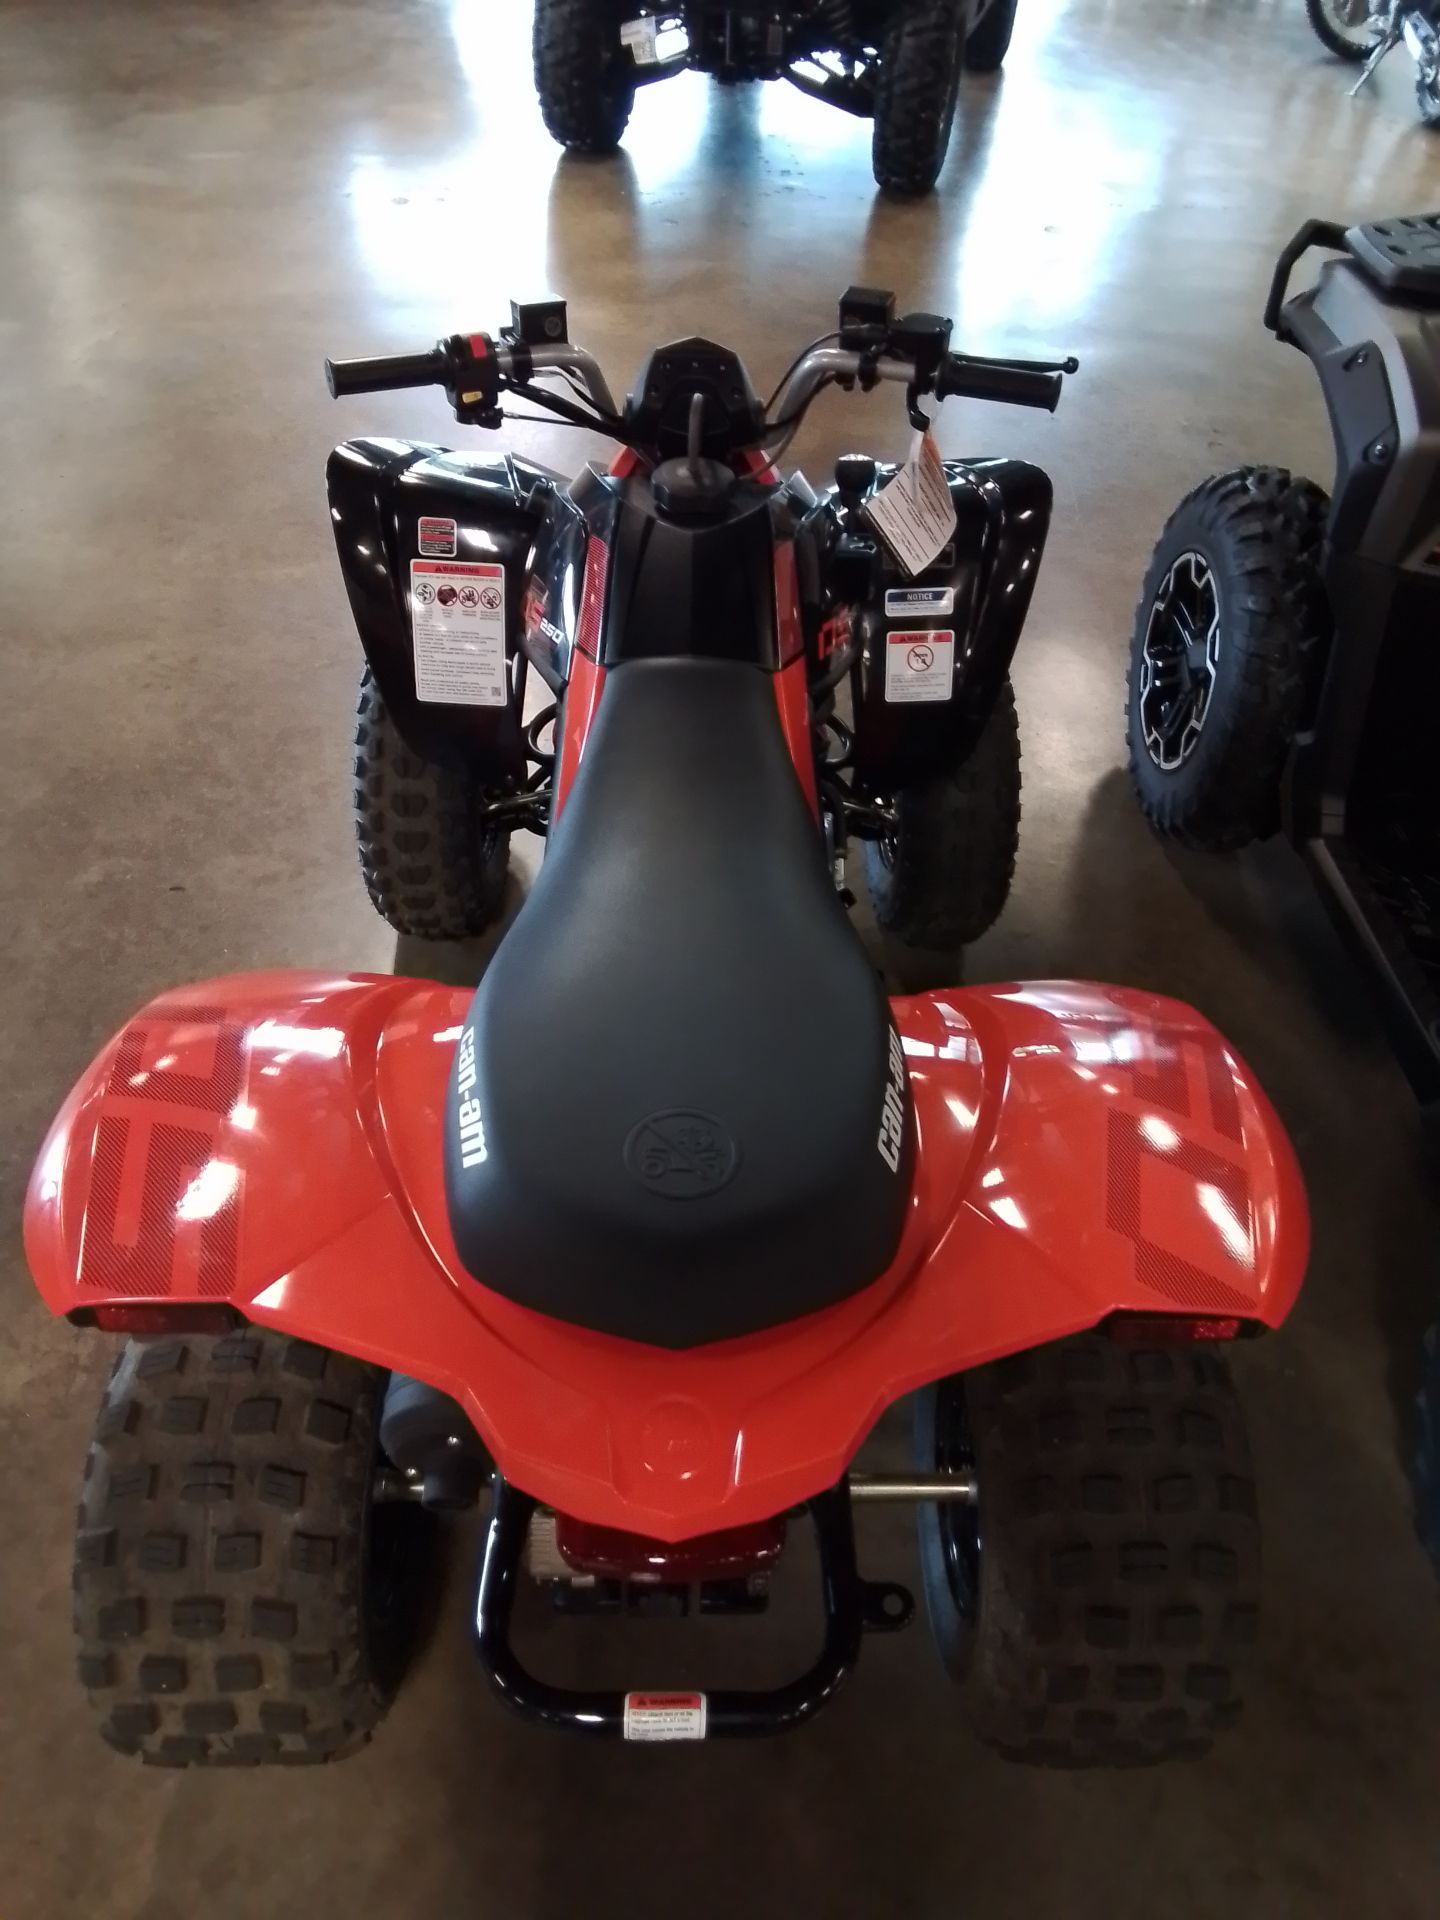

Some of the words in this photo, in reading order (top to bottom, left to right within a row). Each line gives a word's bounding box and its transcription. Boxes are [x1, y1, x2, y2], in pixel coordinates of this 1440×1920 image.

[443, 566, 480, 574] WARNING
[906, 592, 934, 601] NOTICE
[540, 617, 565, 645] 250
[458, 1026, 488, 1169] can-am
